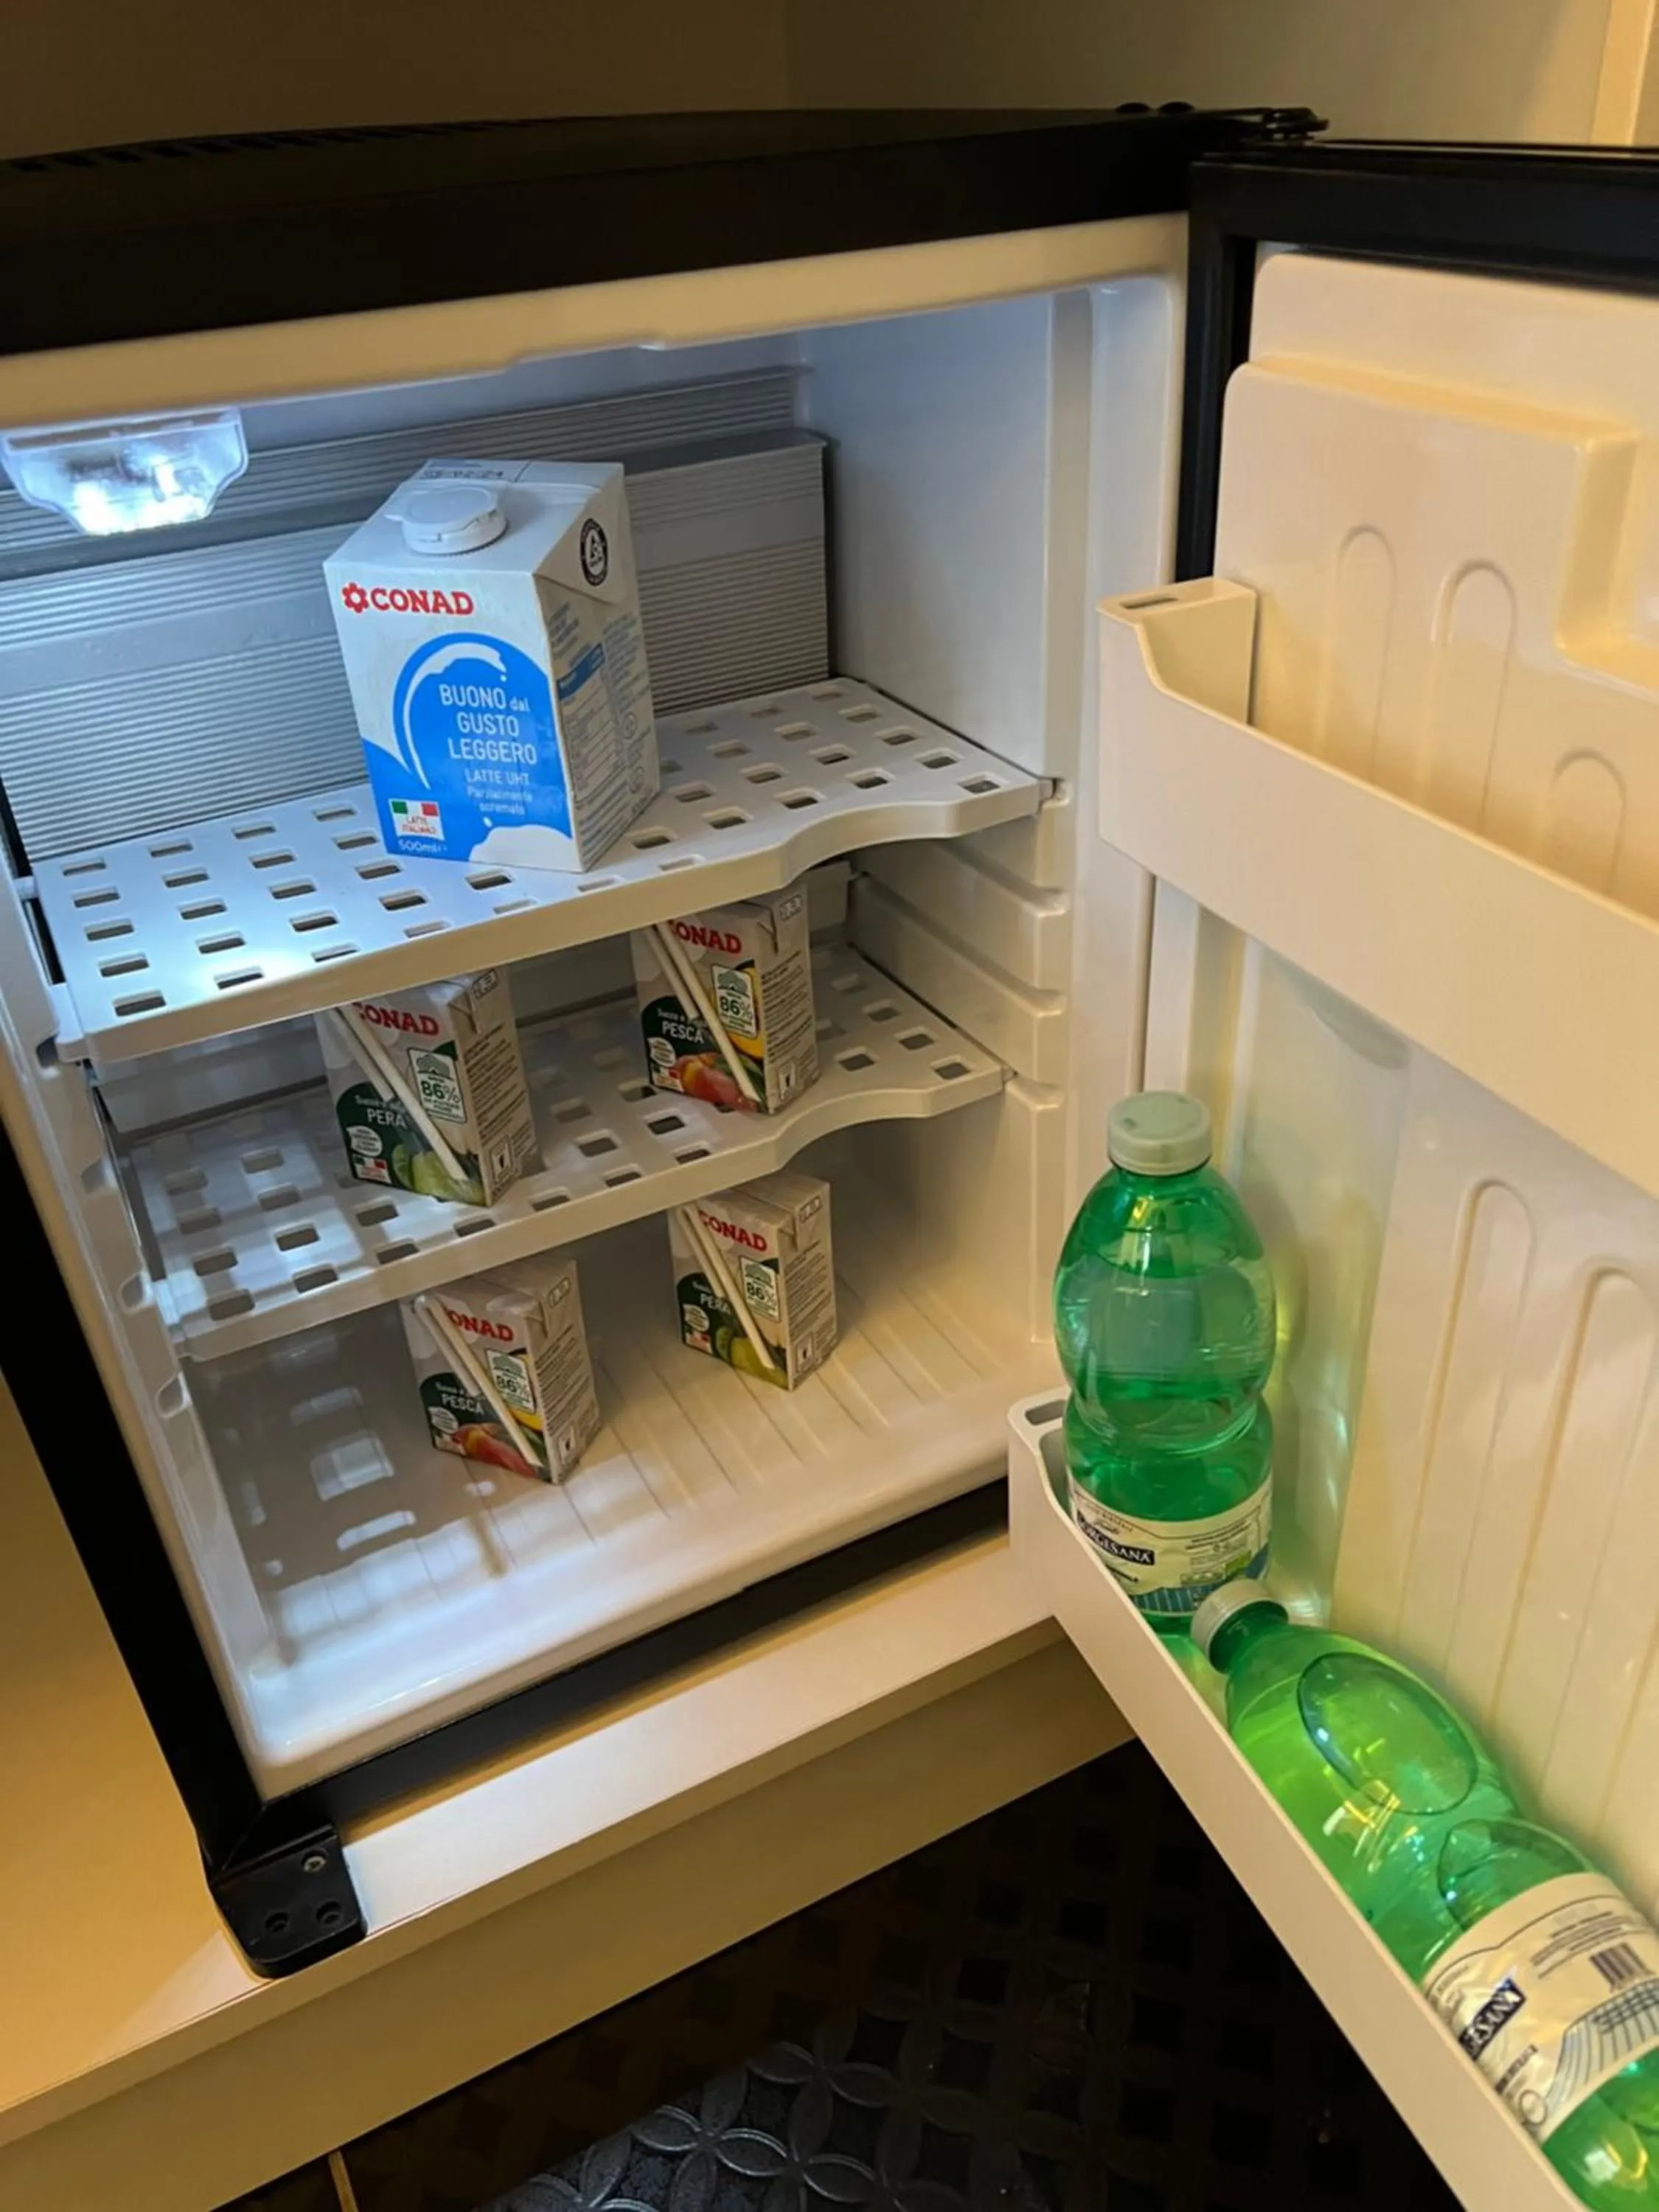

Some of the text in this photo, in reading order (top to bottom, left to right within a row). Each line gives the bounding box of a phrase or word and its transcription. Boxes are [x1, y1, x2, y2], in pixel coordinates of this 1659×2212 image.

[370, 587, 474, 615] CONAD
[439, 684, 531, 712] BUONO dal
[456, 712, 520, 737] GUSTO
[448, 737, 538, 765] LEGGERO
[465, 768, 530, 786] LATTE UHT
[668, 920, 742, 954] ONAD
[720, 996, 754, 1019] 86%
[662, 1020, 705, 1044] PESCA
[420, 1080, 462, 1104] 86%
[366, 1108, 408, 1130] PERA
[446, 1310, 513, 1342] ONAD
[442, 1393, 484, 1416] PESCA
